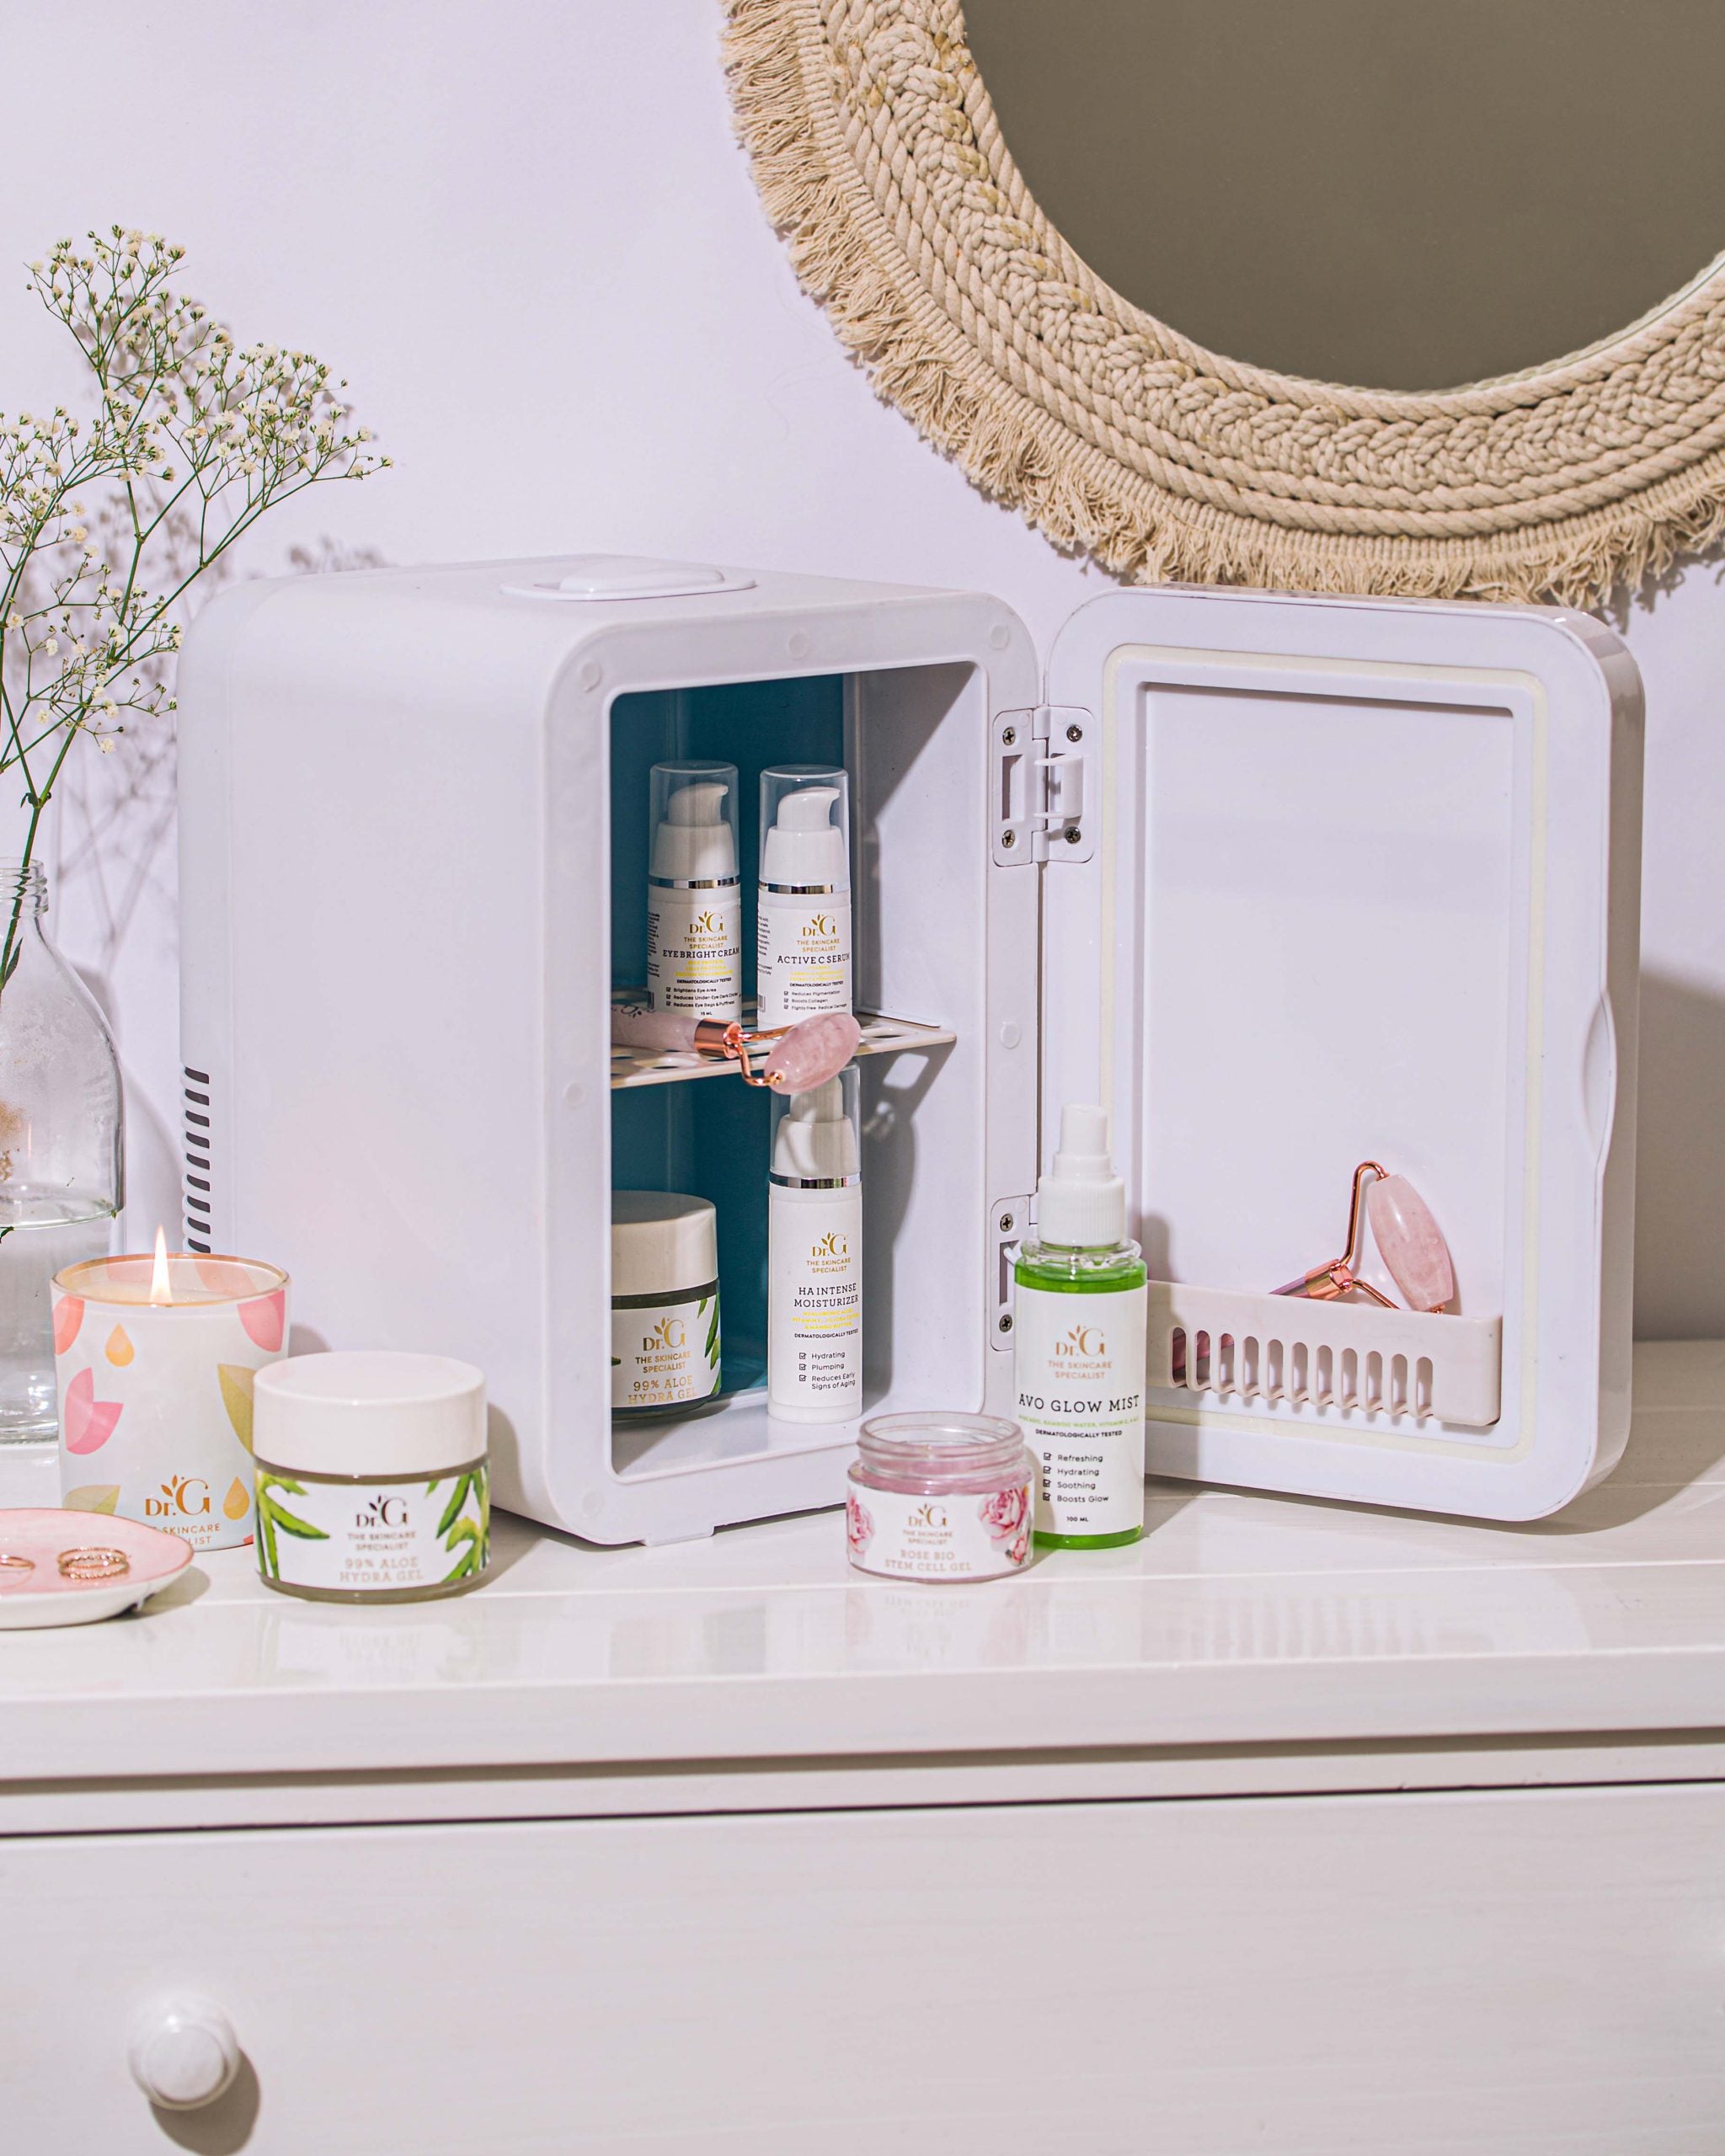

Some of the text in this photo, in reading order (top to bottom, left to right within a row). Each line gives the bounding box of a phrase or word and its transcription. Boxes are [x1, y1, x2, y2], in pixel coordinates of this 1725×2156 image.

[663, 950, 679, 958] EYE
[680, 950, 717, 958] BRIGHT
[777, 955, 816, 964] ACTIVE
[818, 956, 825, 964] C
[821, 1257, 851, 1266] SKINCARE
[812, 1265, 847, 1273] SPECIALIST
[798, 1283, 857, 1295] HA INTENSE
[794, 1294, 858, 1308] MOISTURIZER
[654, 1351, 691, 1363] SKINCARE
[812, 1352, 845, 1360] Hydrating
[643, 1362, 686, 1374] SPECIALIST
[1067, 1361, 1112, 1369] SKINCARE
[633, 1375, 692, 1391] 99% ALOE
[841, 1380, 856, 1388] Aging
[628, 1387, 697, 1404] HYDRA GEL
[1018, 1394, 1140, 1413] AVO GLOW MIST
[1035, 1429, 1099, 1438] DERMATOLOGICALLY
[1058, 1454, 1103, 1463] Refreshing
[1058, 1468, 1099, 1476] Hydrating
[1057, 1481, 1096, 1490] Soothing
[146, 1479, 210, 1516] Dr.G
[163, 1523, 221, 1534] SKINCARE
[369, 1531, 416, 1540] SKINCARE
[355, 1542, 409, 1551] SPECIALIST
[900, 1550, 955, 1559] ROSE BIO
[345, 1556, 419, 1569] 99% ALOE
[885, 1559, 972, 1572] STEM CELL GEL
[339, 1571, 425, 1583] HYDRA GEL
